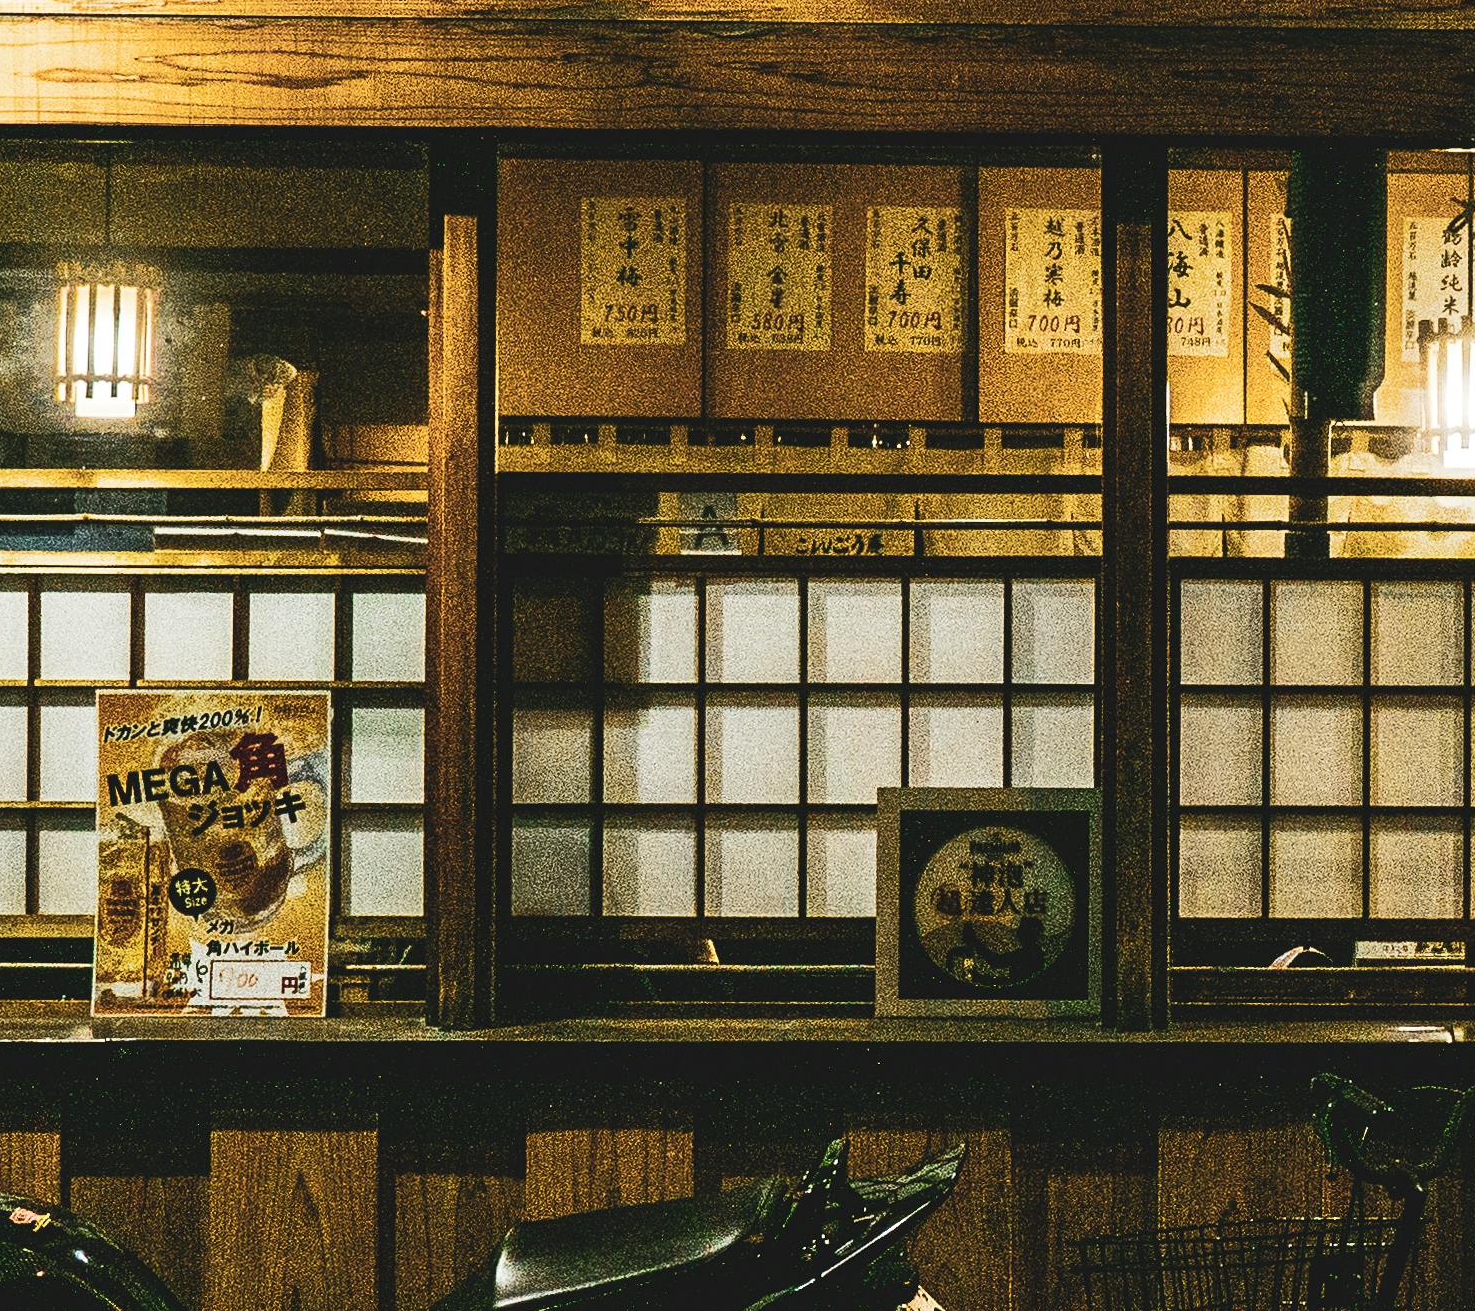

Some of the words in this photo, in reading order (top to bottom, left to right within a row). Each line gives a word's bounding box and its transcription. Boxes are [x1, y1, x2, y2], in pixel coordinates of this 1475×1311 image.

[911, 216, 933, 280] 久保田
[1043, 215, 1065, 309] 越乃寒梅
[889, 310, 941, 331] 700円
[1028, 314, 1080, 334] 700円
[107, 761, 229, 807] MEGA
[230, 732, 288, 792] 角
[174, 877, 208, 895] 特大
[206, 940, 298, 955] 角ハイボール
